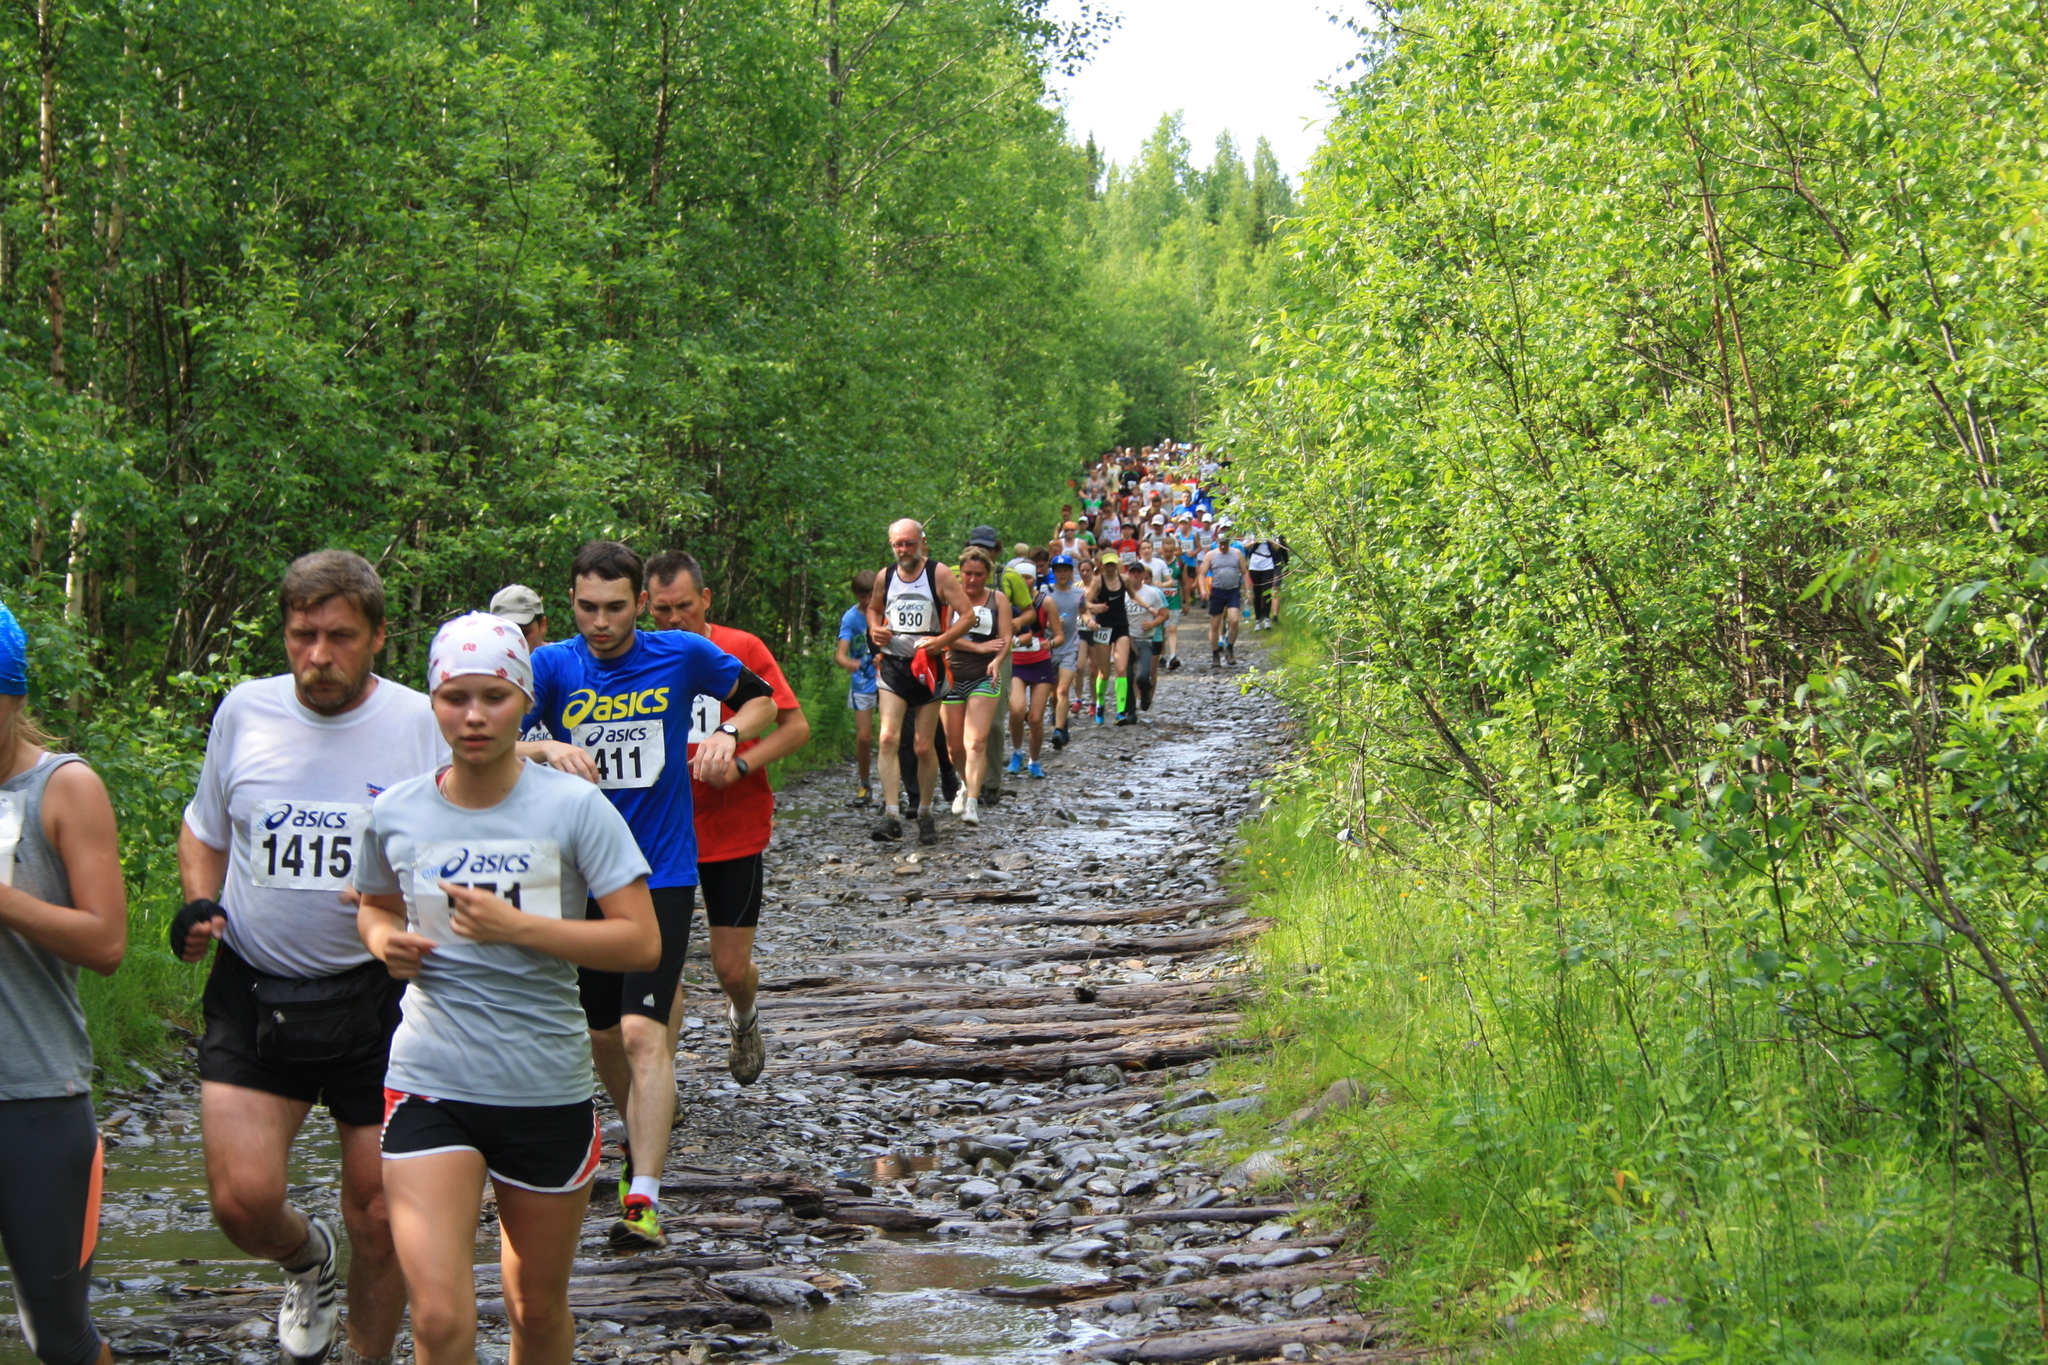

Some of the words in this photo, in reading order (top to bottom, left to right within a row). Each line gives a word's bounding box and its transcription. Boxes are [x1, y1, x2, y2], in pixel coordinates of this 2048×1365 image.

[898, 612, 923, 627] 930
[592, 687, 670, 721] asics
[605, 727, 647, 743] asics
[594, 746, 642, 780] 411
[291, 810, 348, 829] asics
[262, 833, 352, 879] 1415
[470, 854, 530, 873] asics
